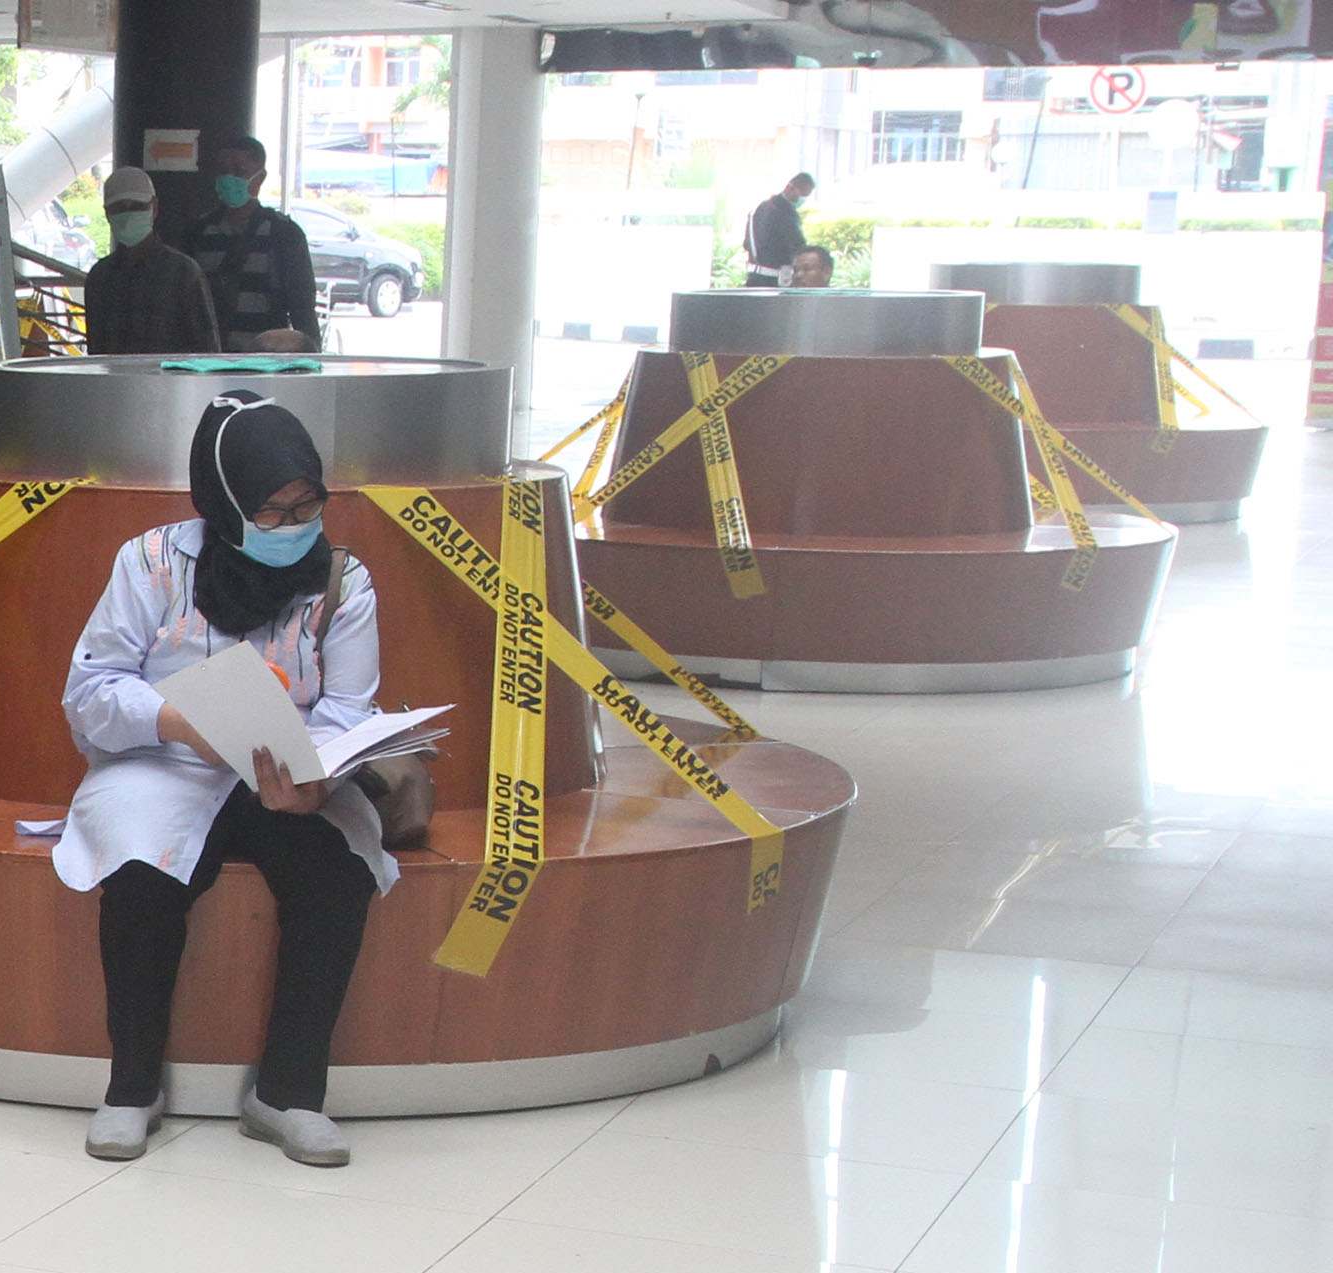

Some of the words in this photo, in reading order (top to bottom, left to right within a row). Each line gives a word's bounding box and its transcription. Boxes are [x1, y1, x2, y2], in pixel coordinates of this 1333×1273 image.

[700, 357, 778, 416] CAUTION
[399, 507, 427, 533] DO
[427, 534, 467, 567] NOT
[412, 495, 501, 588] CAUTI
[725, 497, 755, 571] CAUTION
[504, 582, 520, 607] DO
[503, 610, 519, 646] NOT
[517, 593, 544, 715] CAUTION
[499, 647, 517, 705] ENTER
[592, 684, 620, 708] DO
[621, 709, 658, 743] NOT
[660, 745, 728, 801] ENTER
[601, 673, 731, 796] CAUTION
[496, 772, 511, 798] DO
[486, 779, 540, 923] CAUTION
[493, 801, 510, 841] NOT
[468, 843, 510, 913] ENTER
